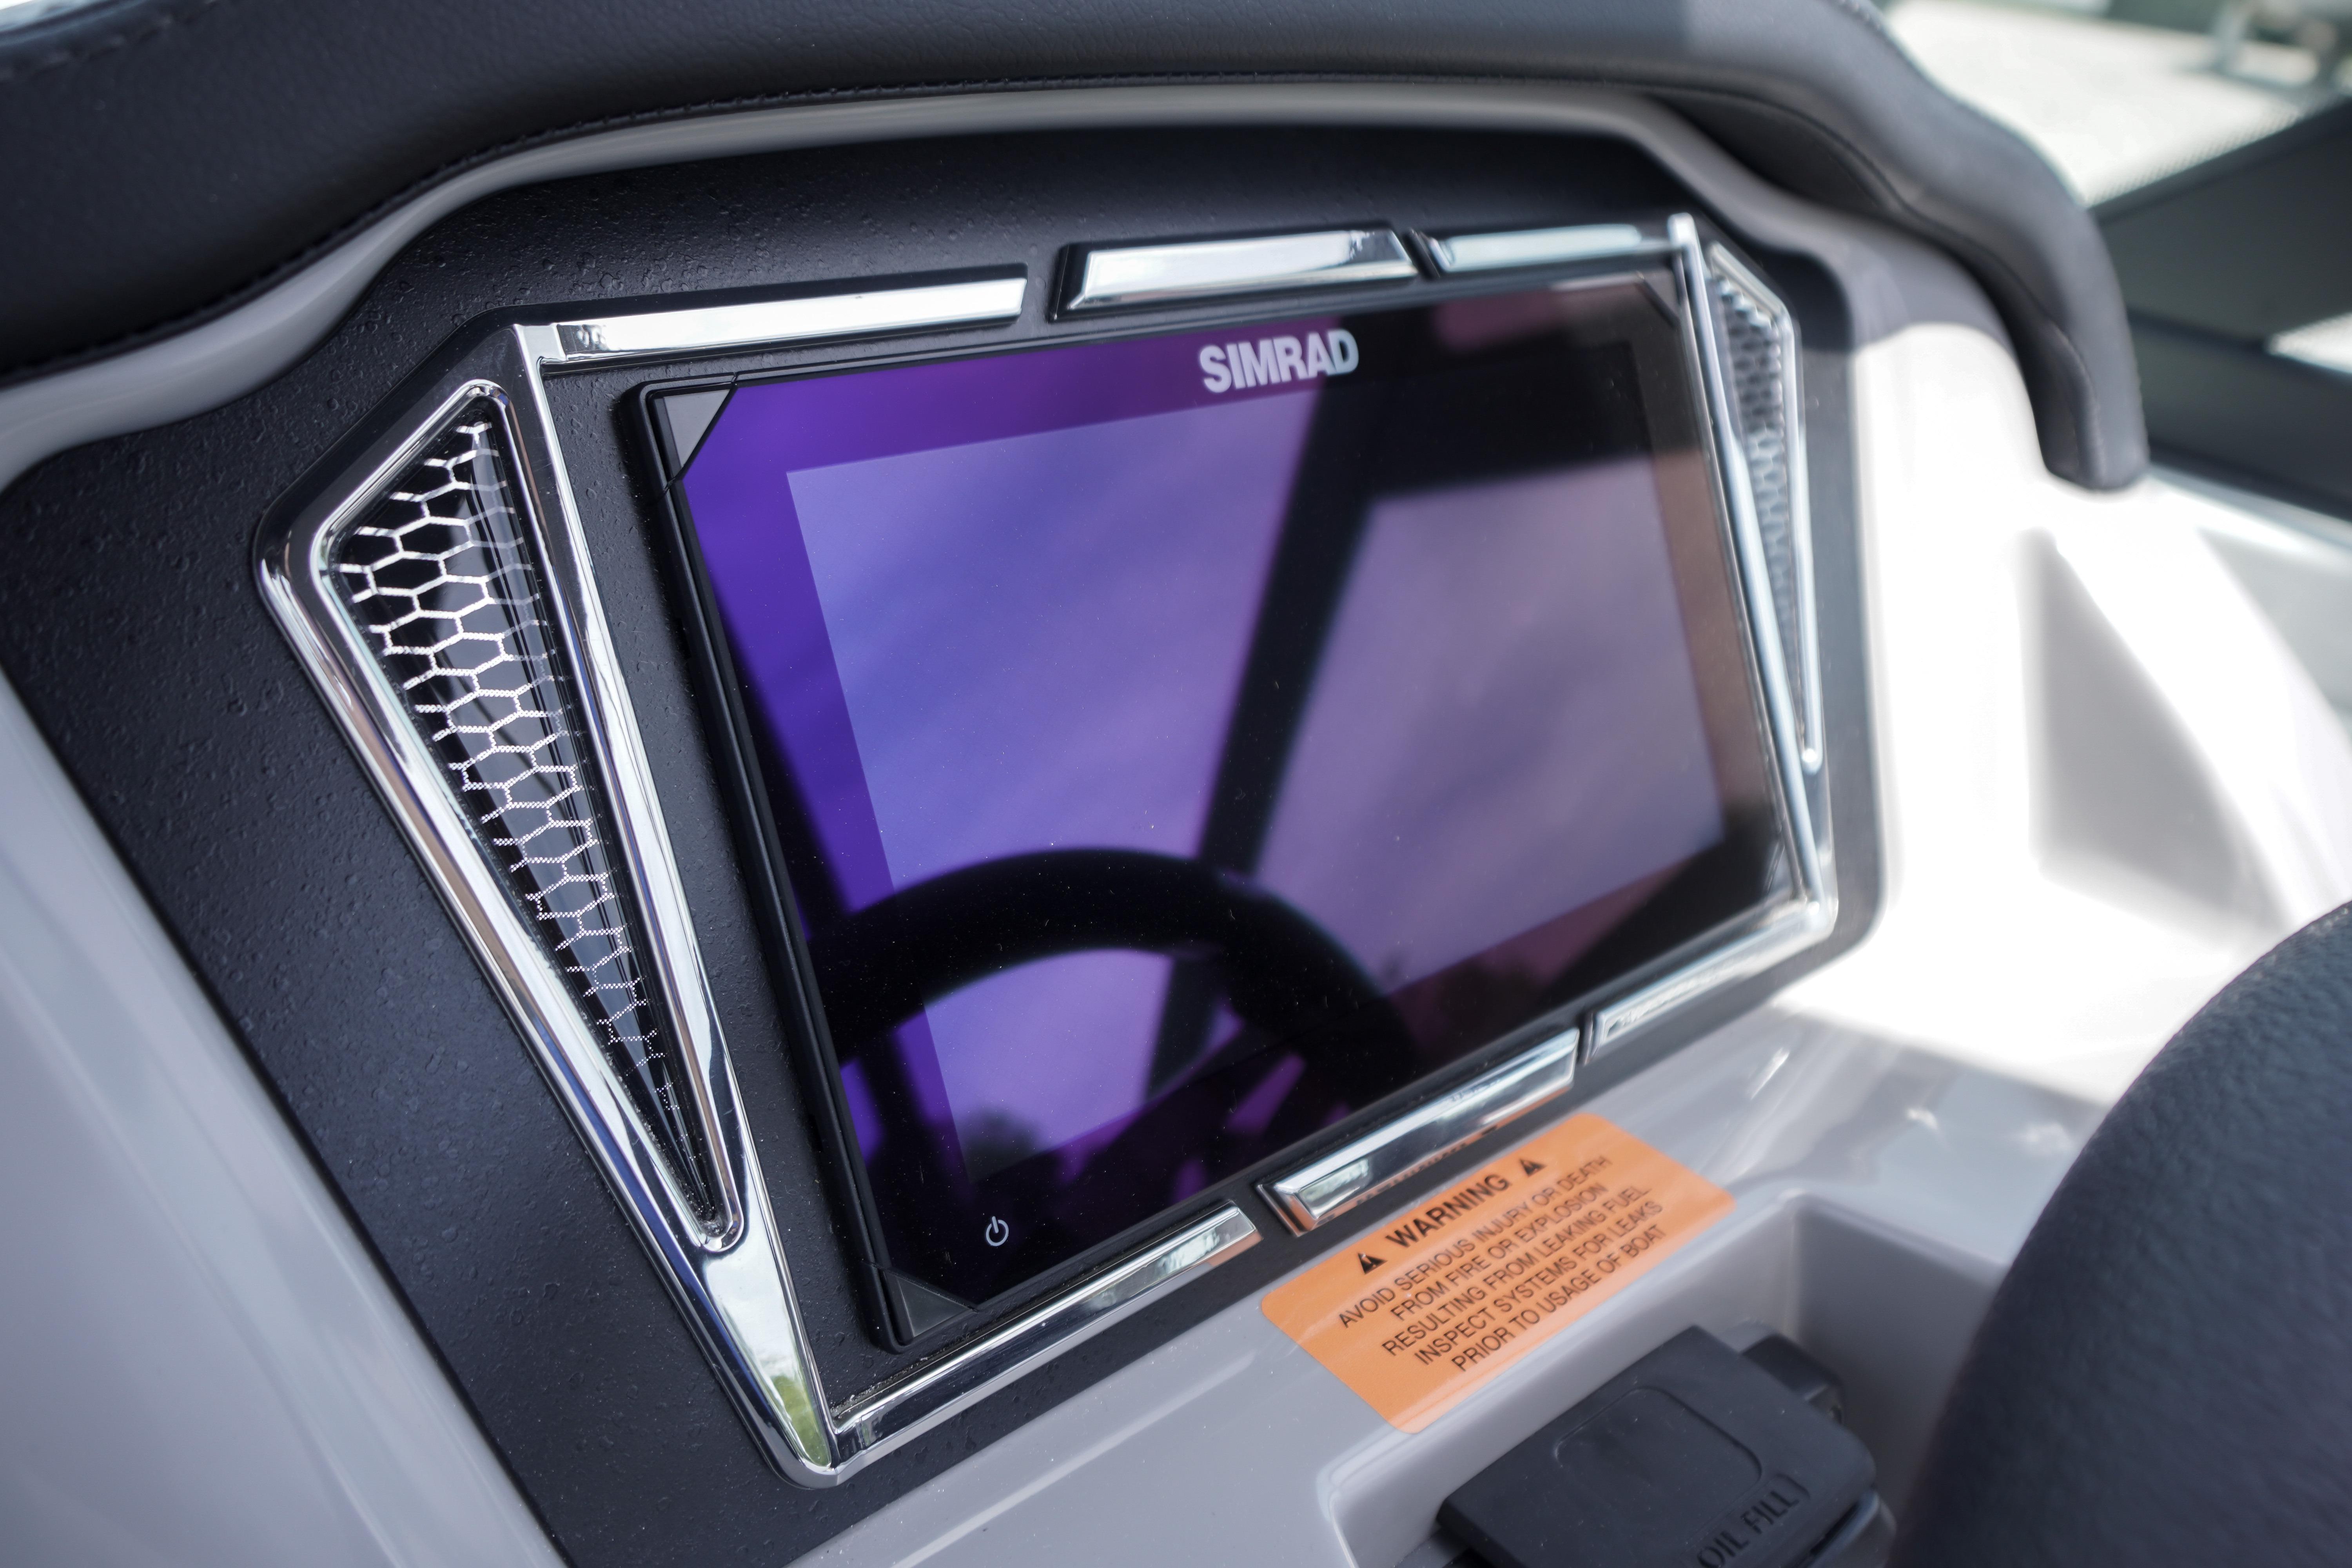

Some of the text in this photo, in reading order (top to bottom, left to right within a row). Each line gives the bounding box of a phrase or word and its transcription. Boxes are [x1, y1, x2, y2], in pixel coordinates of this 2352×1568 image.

[1200, 328, 1359, 393] SIMRAD
[1339, 1156, 1613, 1329] AVOID SERIOUS INJURY OR DEATH
[1381, 1186, 1652, 1356] RESULTING FROM LEAKING FUEL
[1385, 1174, 1510, 1248] WARNING
[1390, 1182, 1608, 1321] FROM FIRE OR EXPLOSION
[1414, 1201, 1663, 1365] INSPECT SYSTEMS FOR LEAKS
[1451, 1224, 1666, 1372] PRIOR TO USAGE OF BOAT
[1697, 1490, 1800, 1568] OIL FILL
